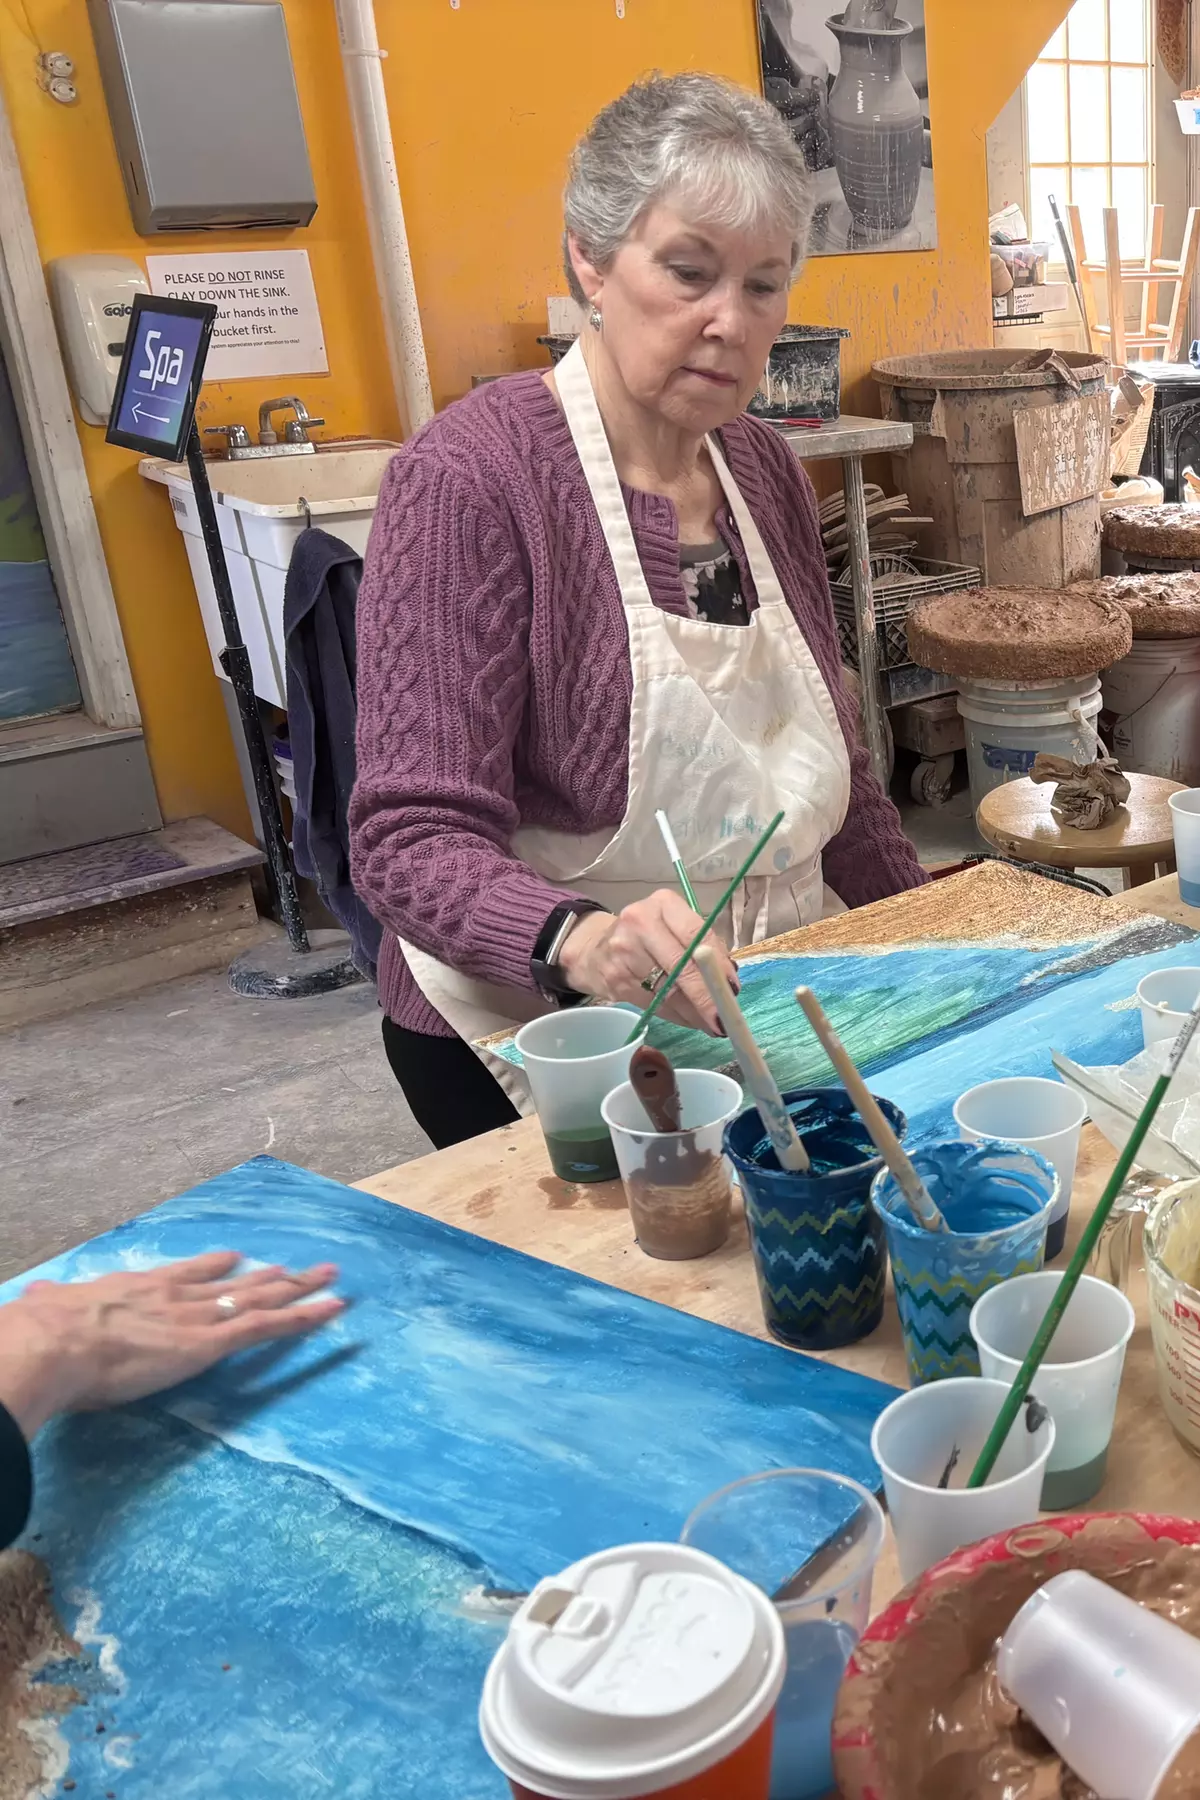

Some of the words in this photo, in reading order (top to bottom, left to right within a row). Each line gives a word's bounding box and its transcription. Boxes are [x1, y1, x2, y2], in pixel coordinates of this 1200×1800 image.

[164, 272, 205, 285] PLEASE
[208, 272, 225, 283] DO
[227, 271, 251, 282] NOT
[254, 269, 285, 280] RINSE
[198, 289, 236, 301] DOWN
[238, 288, 260, 299] THE
[262, 286, 291, 297] SINK.
[233, 305, 266, 318] hands
[268, 306, 278, 317] in
[280, 305, 299, 316] the
[212, 324, 250, 337] bucket
[251, 323, 276, 335] first.
[138, 330, 184, 391] Spa
